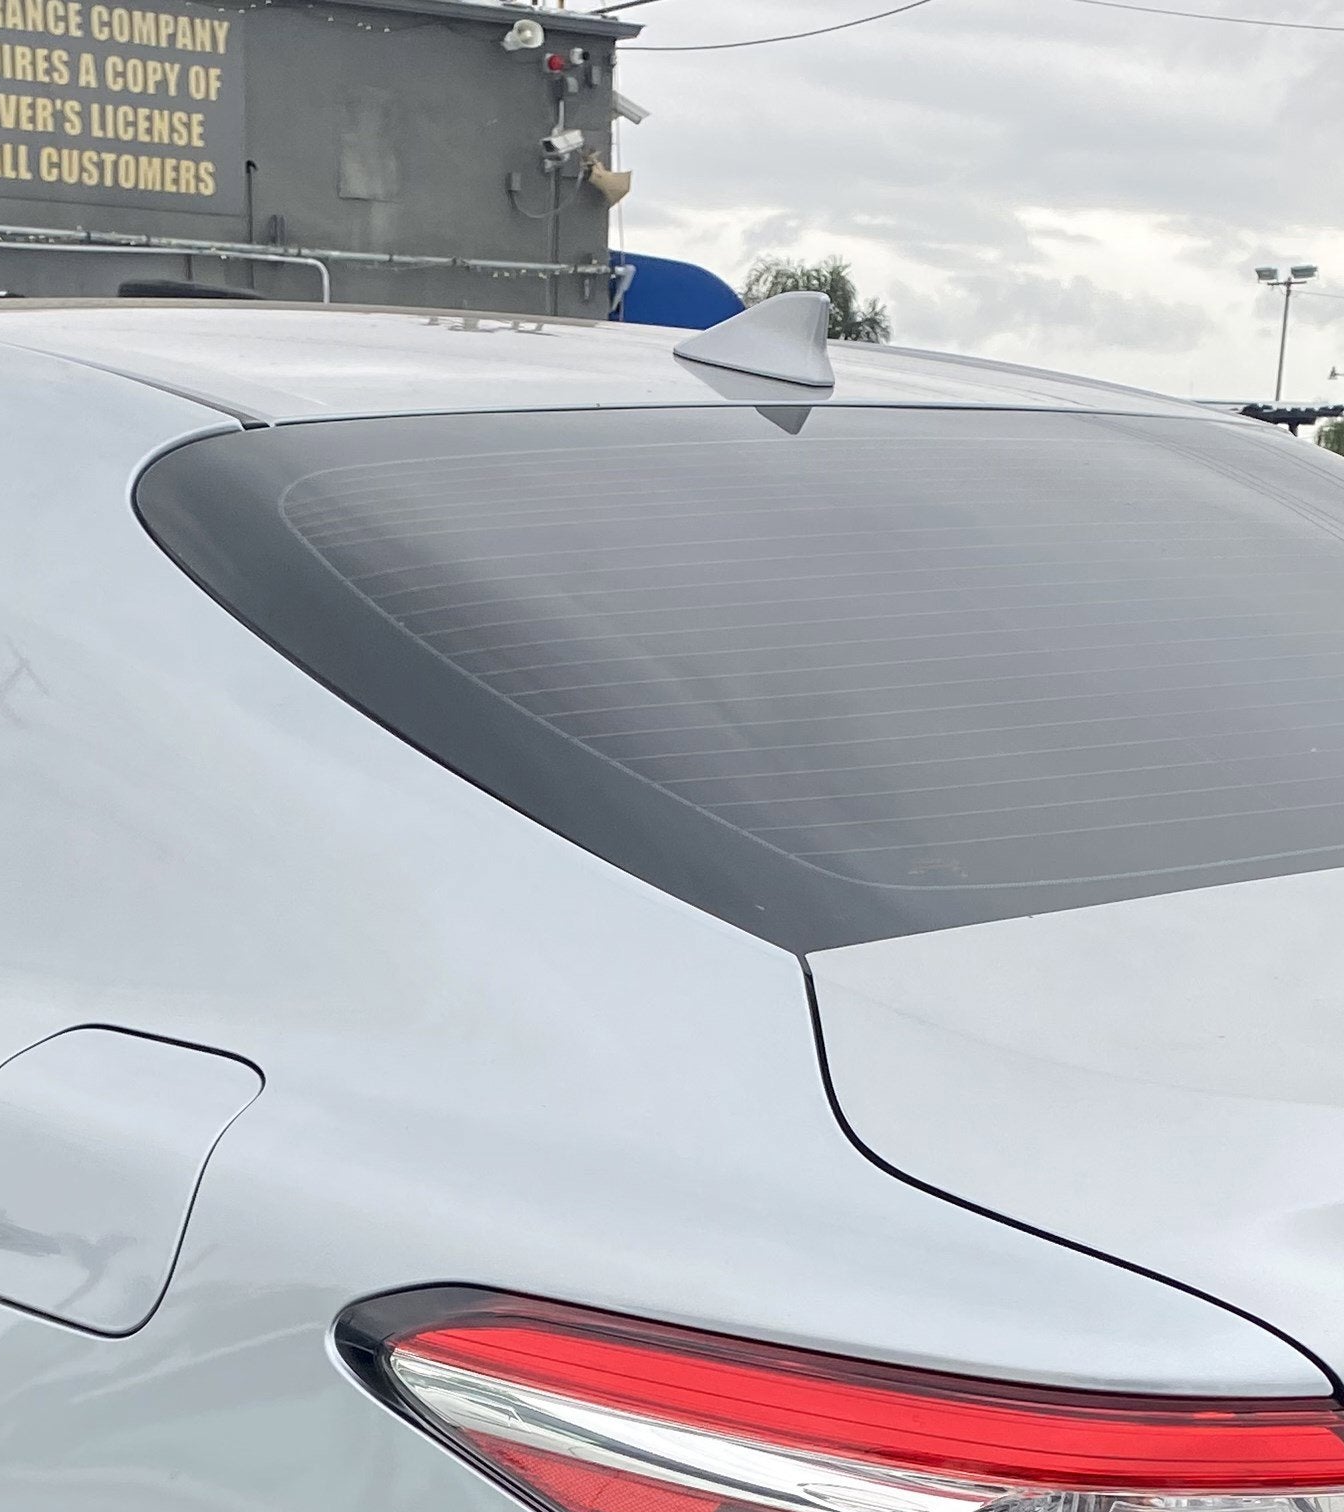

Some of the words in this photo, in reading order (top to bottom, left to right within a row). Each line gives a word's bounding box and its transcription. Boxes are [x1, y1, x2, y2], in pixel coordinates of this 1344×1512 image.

[89, 4, 231, 54] COMPANY
[77, 52, 98, 89] A
[105, 54, 181, 98] COPY
[188, 65, 223, 102] OF
[90, 102, 206, 148] LICENSE
[39, 147, 216, 197] CUSTOMERS
